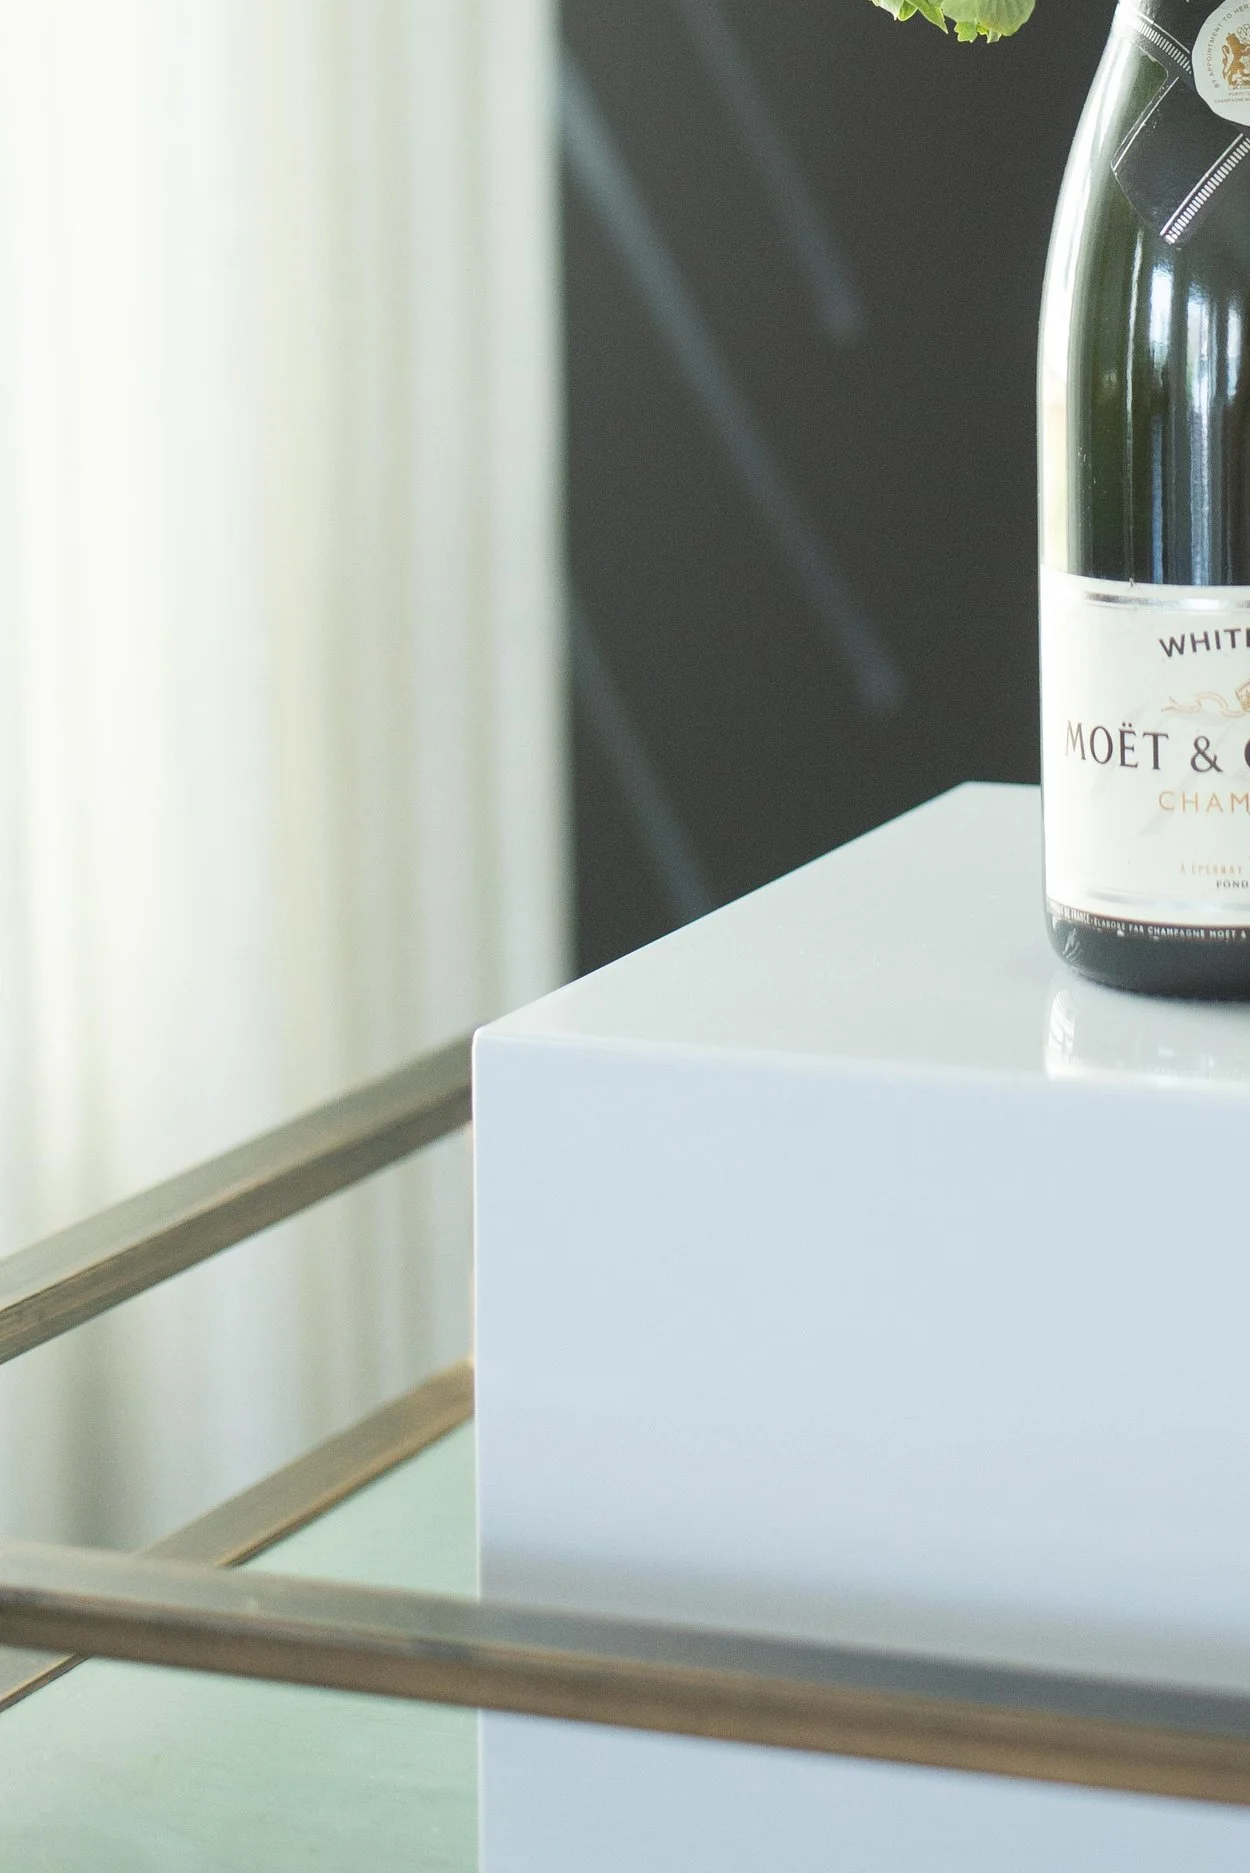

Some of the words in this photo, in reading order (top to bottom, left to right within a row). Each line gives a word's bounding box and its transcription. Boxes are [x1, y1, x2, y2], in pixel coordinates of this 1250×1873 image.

[1206, 23, 1223, 77] APPOINTMENT
[1222, 12, 1233, 22] TO
[1233, 3, 1250, 15] HER
[1065, 721, 1170, 771] MOËT
[1189, 735, 1224, 773] &
[1128, 923, 1144, 934] PAR
[1147, 925, 1205, 938] CHAMPAGNE
